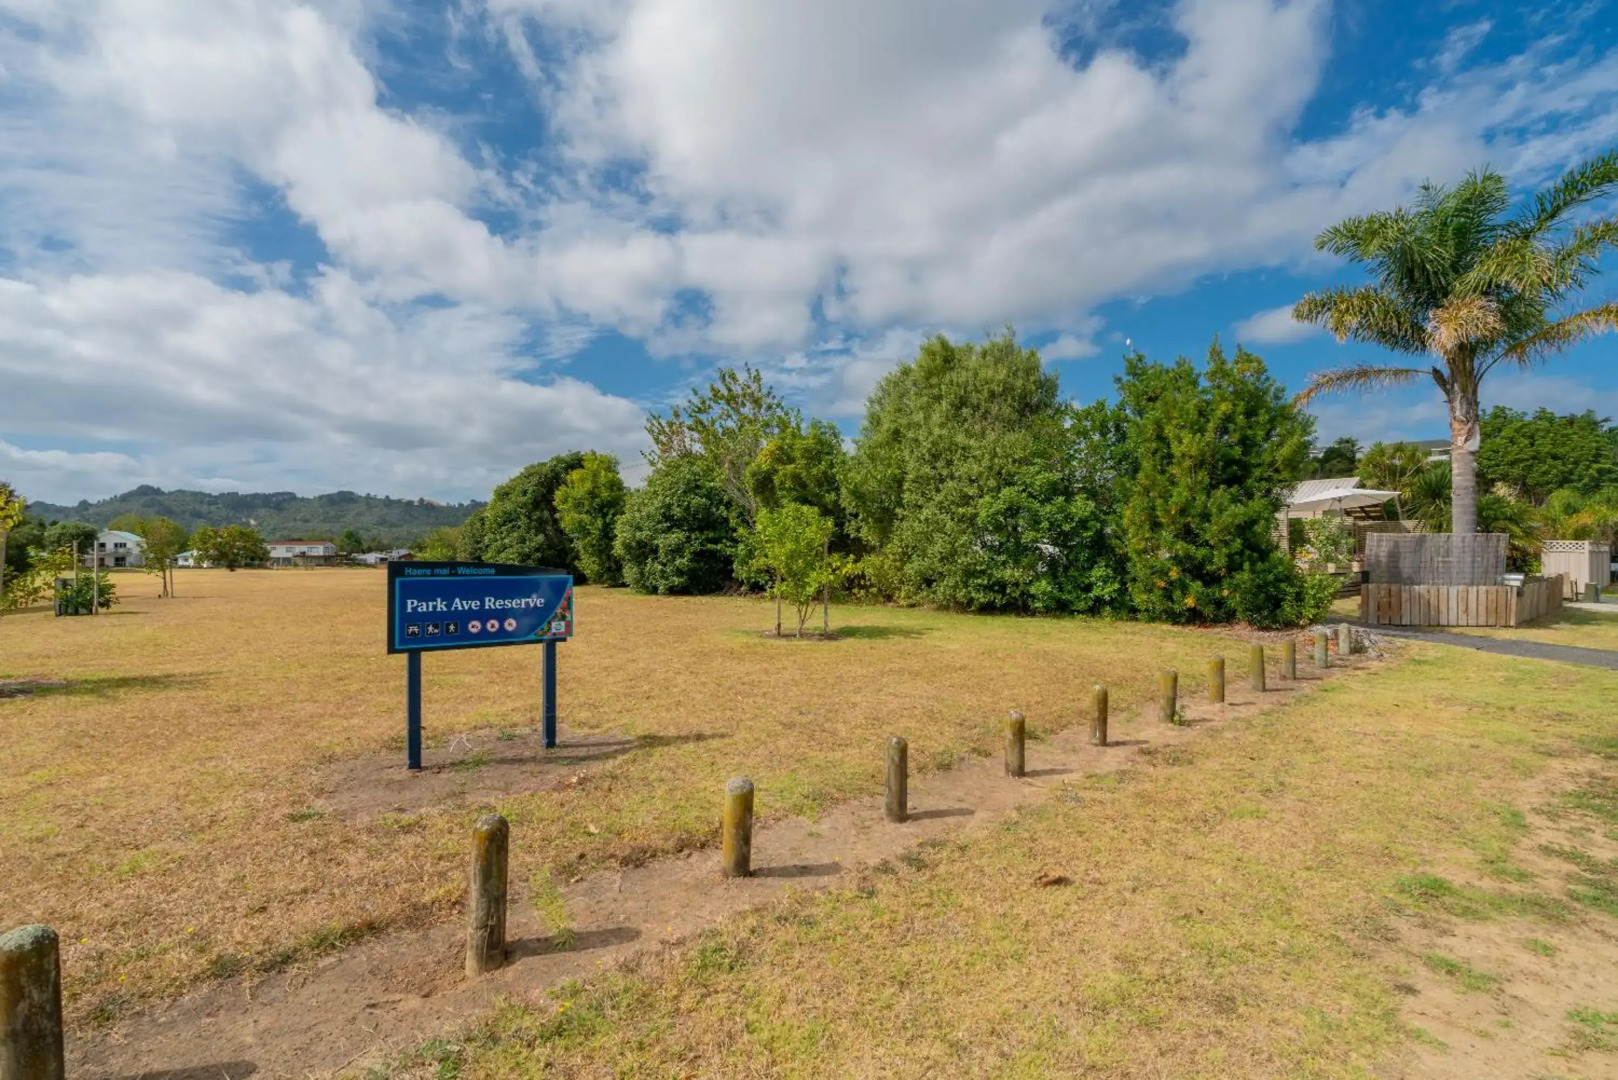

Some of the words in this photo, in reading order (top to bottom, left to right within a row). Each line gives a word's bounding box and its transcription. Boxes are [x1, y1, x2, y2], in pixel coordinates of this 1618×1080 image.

[457, 566, 496, 575] Welcome
[406, 598, 448, 613] Park
[451, 597, 481, 611] Ave
[484, 596, 545, 610] Reserve
